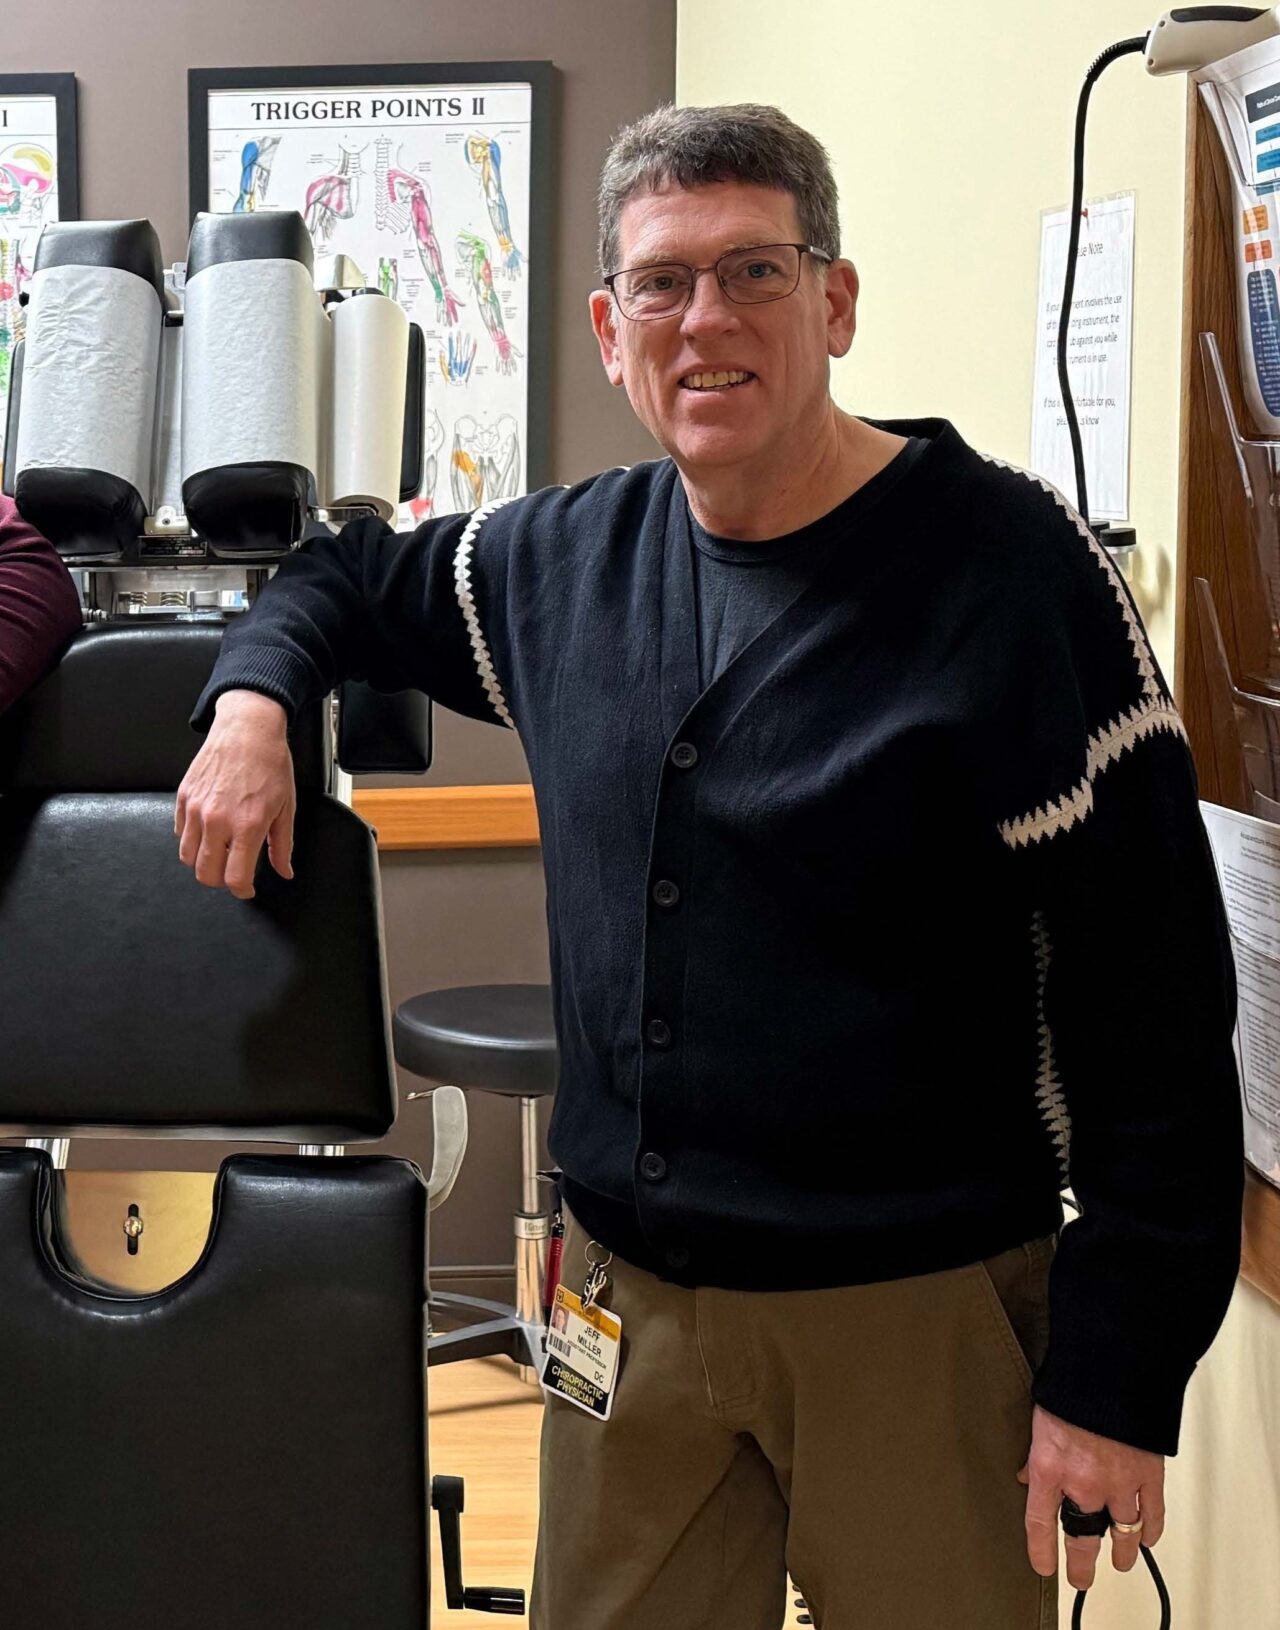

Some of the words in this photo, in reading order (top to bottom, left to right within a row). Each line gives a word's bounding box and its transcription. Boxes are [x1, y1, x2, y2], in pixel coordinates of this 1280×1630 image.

[2, 110, 8, 127] I
[251, 101, 362, 120] TRIGGER
[371, 98, 462, 118] POINTS
[472, 97, 485, 115] II
[1088, 242, 1104, 255] Note
[584, 1325, 602, 1342] JEFF
[577, 1334, 602, 1359] MILLER
[551, 1365, 605, 1401] CHIROPRACTIC
[593, 1370, 605, 1385] DC
[556, 1379, 596, 1408] PHYSICIAN
